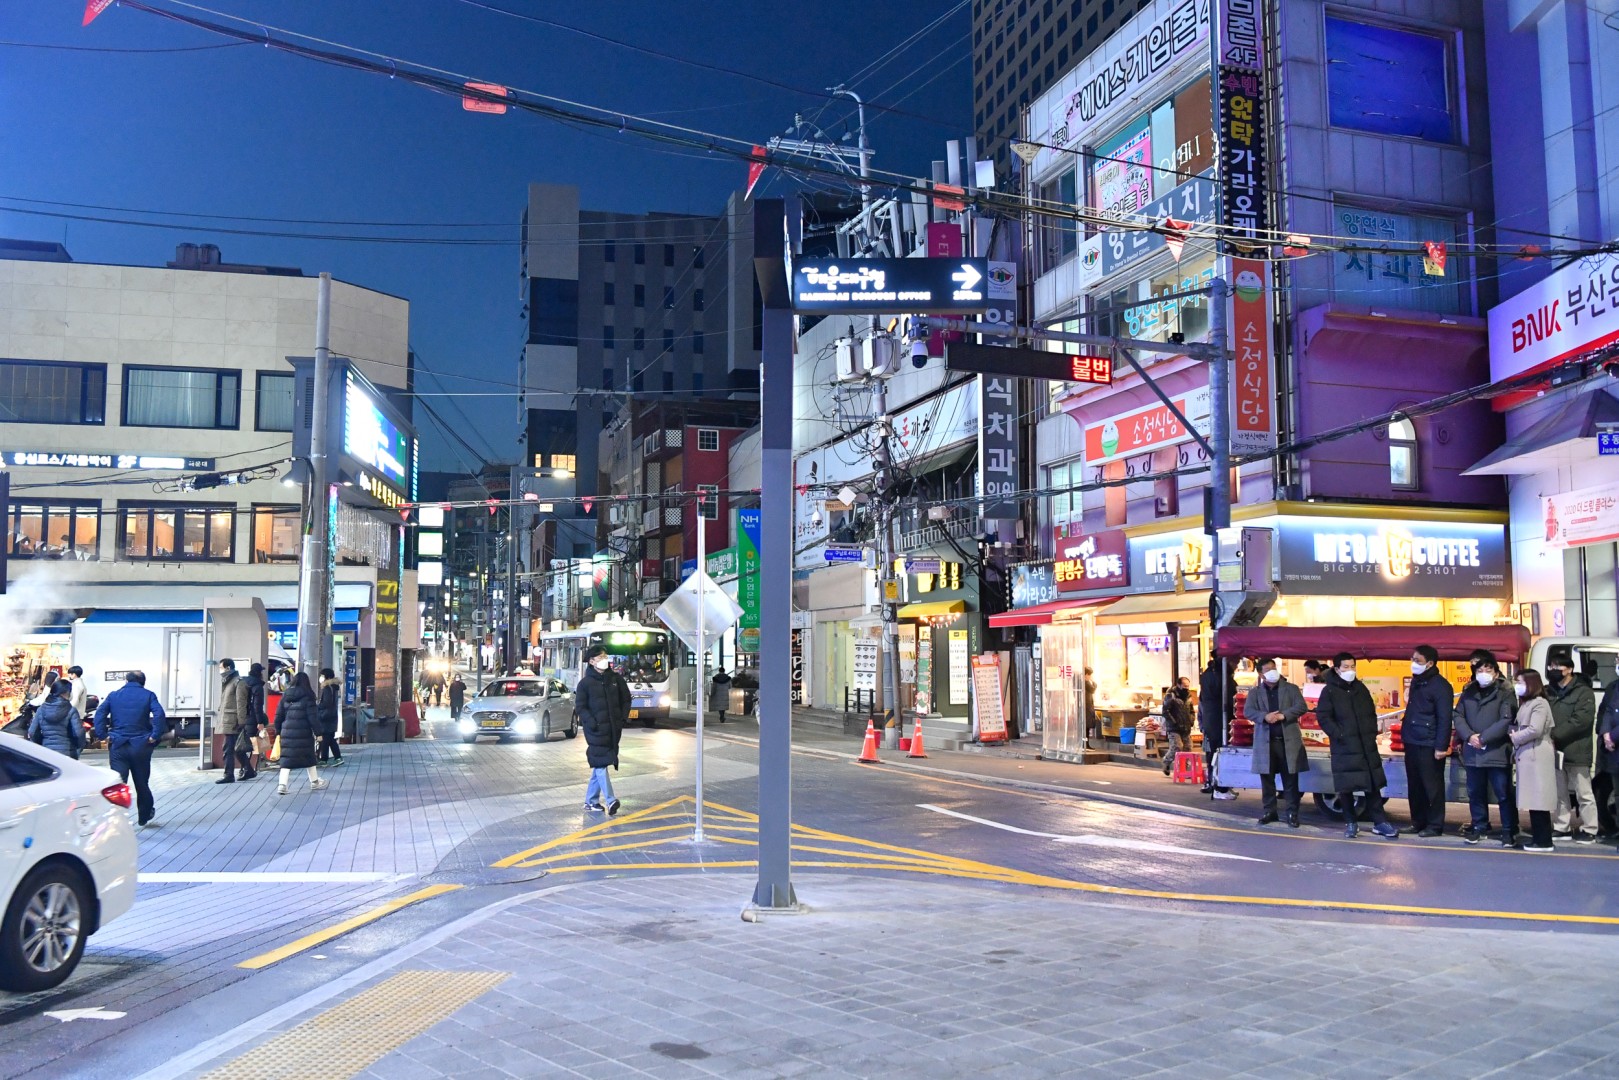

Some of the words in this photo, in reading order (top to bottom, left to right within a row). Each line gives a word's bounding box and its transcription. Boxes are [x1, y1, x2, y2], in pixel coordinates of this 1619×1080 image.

[1080, 0, 1198, 121] 에이스게임존
[1226, 46, 1257, 65] 4F
[1225, 74, 1257, 96] 수빈
[1231, 148, 1257, 238] 가라오케
[1342, 213, 1396, 239] 양현식
[1511, 298, 1562, 353] BNK
[1072, 355, 1111, 383] 불법
[1240, 320, 1265, 425] 소정식당
[1132, 407, 1180, 446] 소정식당
[117, 454, 138, 468] 2F
[740, 515, 759, 523] NH
[1411, 536, 1481, 567] COFFEE
[1031, 565, 1045, 581] 수빈
[1154, 575, 1168, 583] BIG
[1323, 563, 1346, 573] BIG
[1352, 563, 1381, 574] SIZE
[1414, 565, 1421, 575] 2
[1426, 566, 1458, 575] SHOT
[1021, 583, 1057, 606] 가라오케
[745, 613, 758, 621] 365
